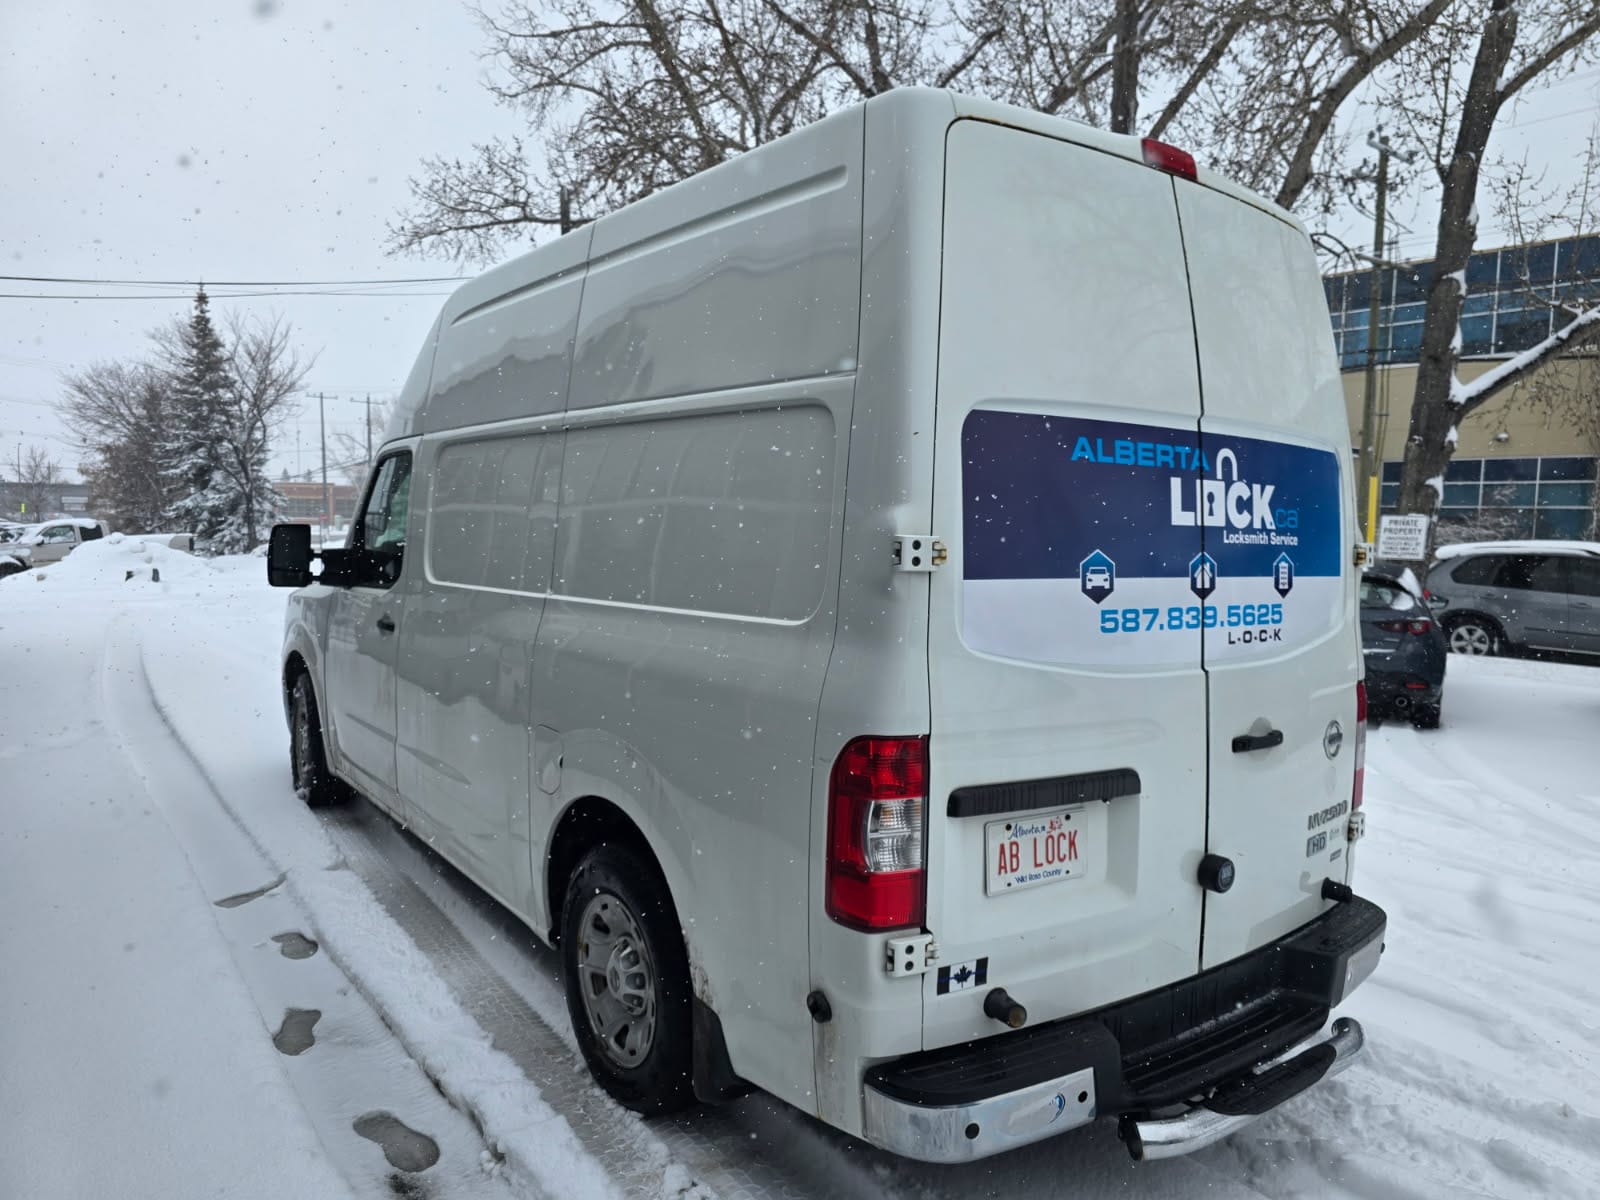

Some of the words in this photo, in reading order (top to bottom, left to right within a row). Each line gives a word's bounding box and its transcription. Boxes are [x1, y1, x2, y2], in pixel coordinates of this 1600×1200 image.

[1071, 436, 1210, 471] ALBERTA
[1383, 527, 1422, 536] PROPERTY
[1388, 519, 1418, 527] PRIVATE
[1223, 530, 1269, 545] Locksmith
[1270, 532, 1299, 546] Service
[1100, 604, 1283, 633] 587.839.5625
[998, 840, 1020, 876] AB
[1033, 829, 1079, 868] LOCK
